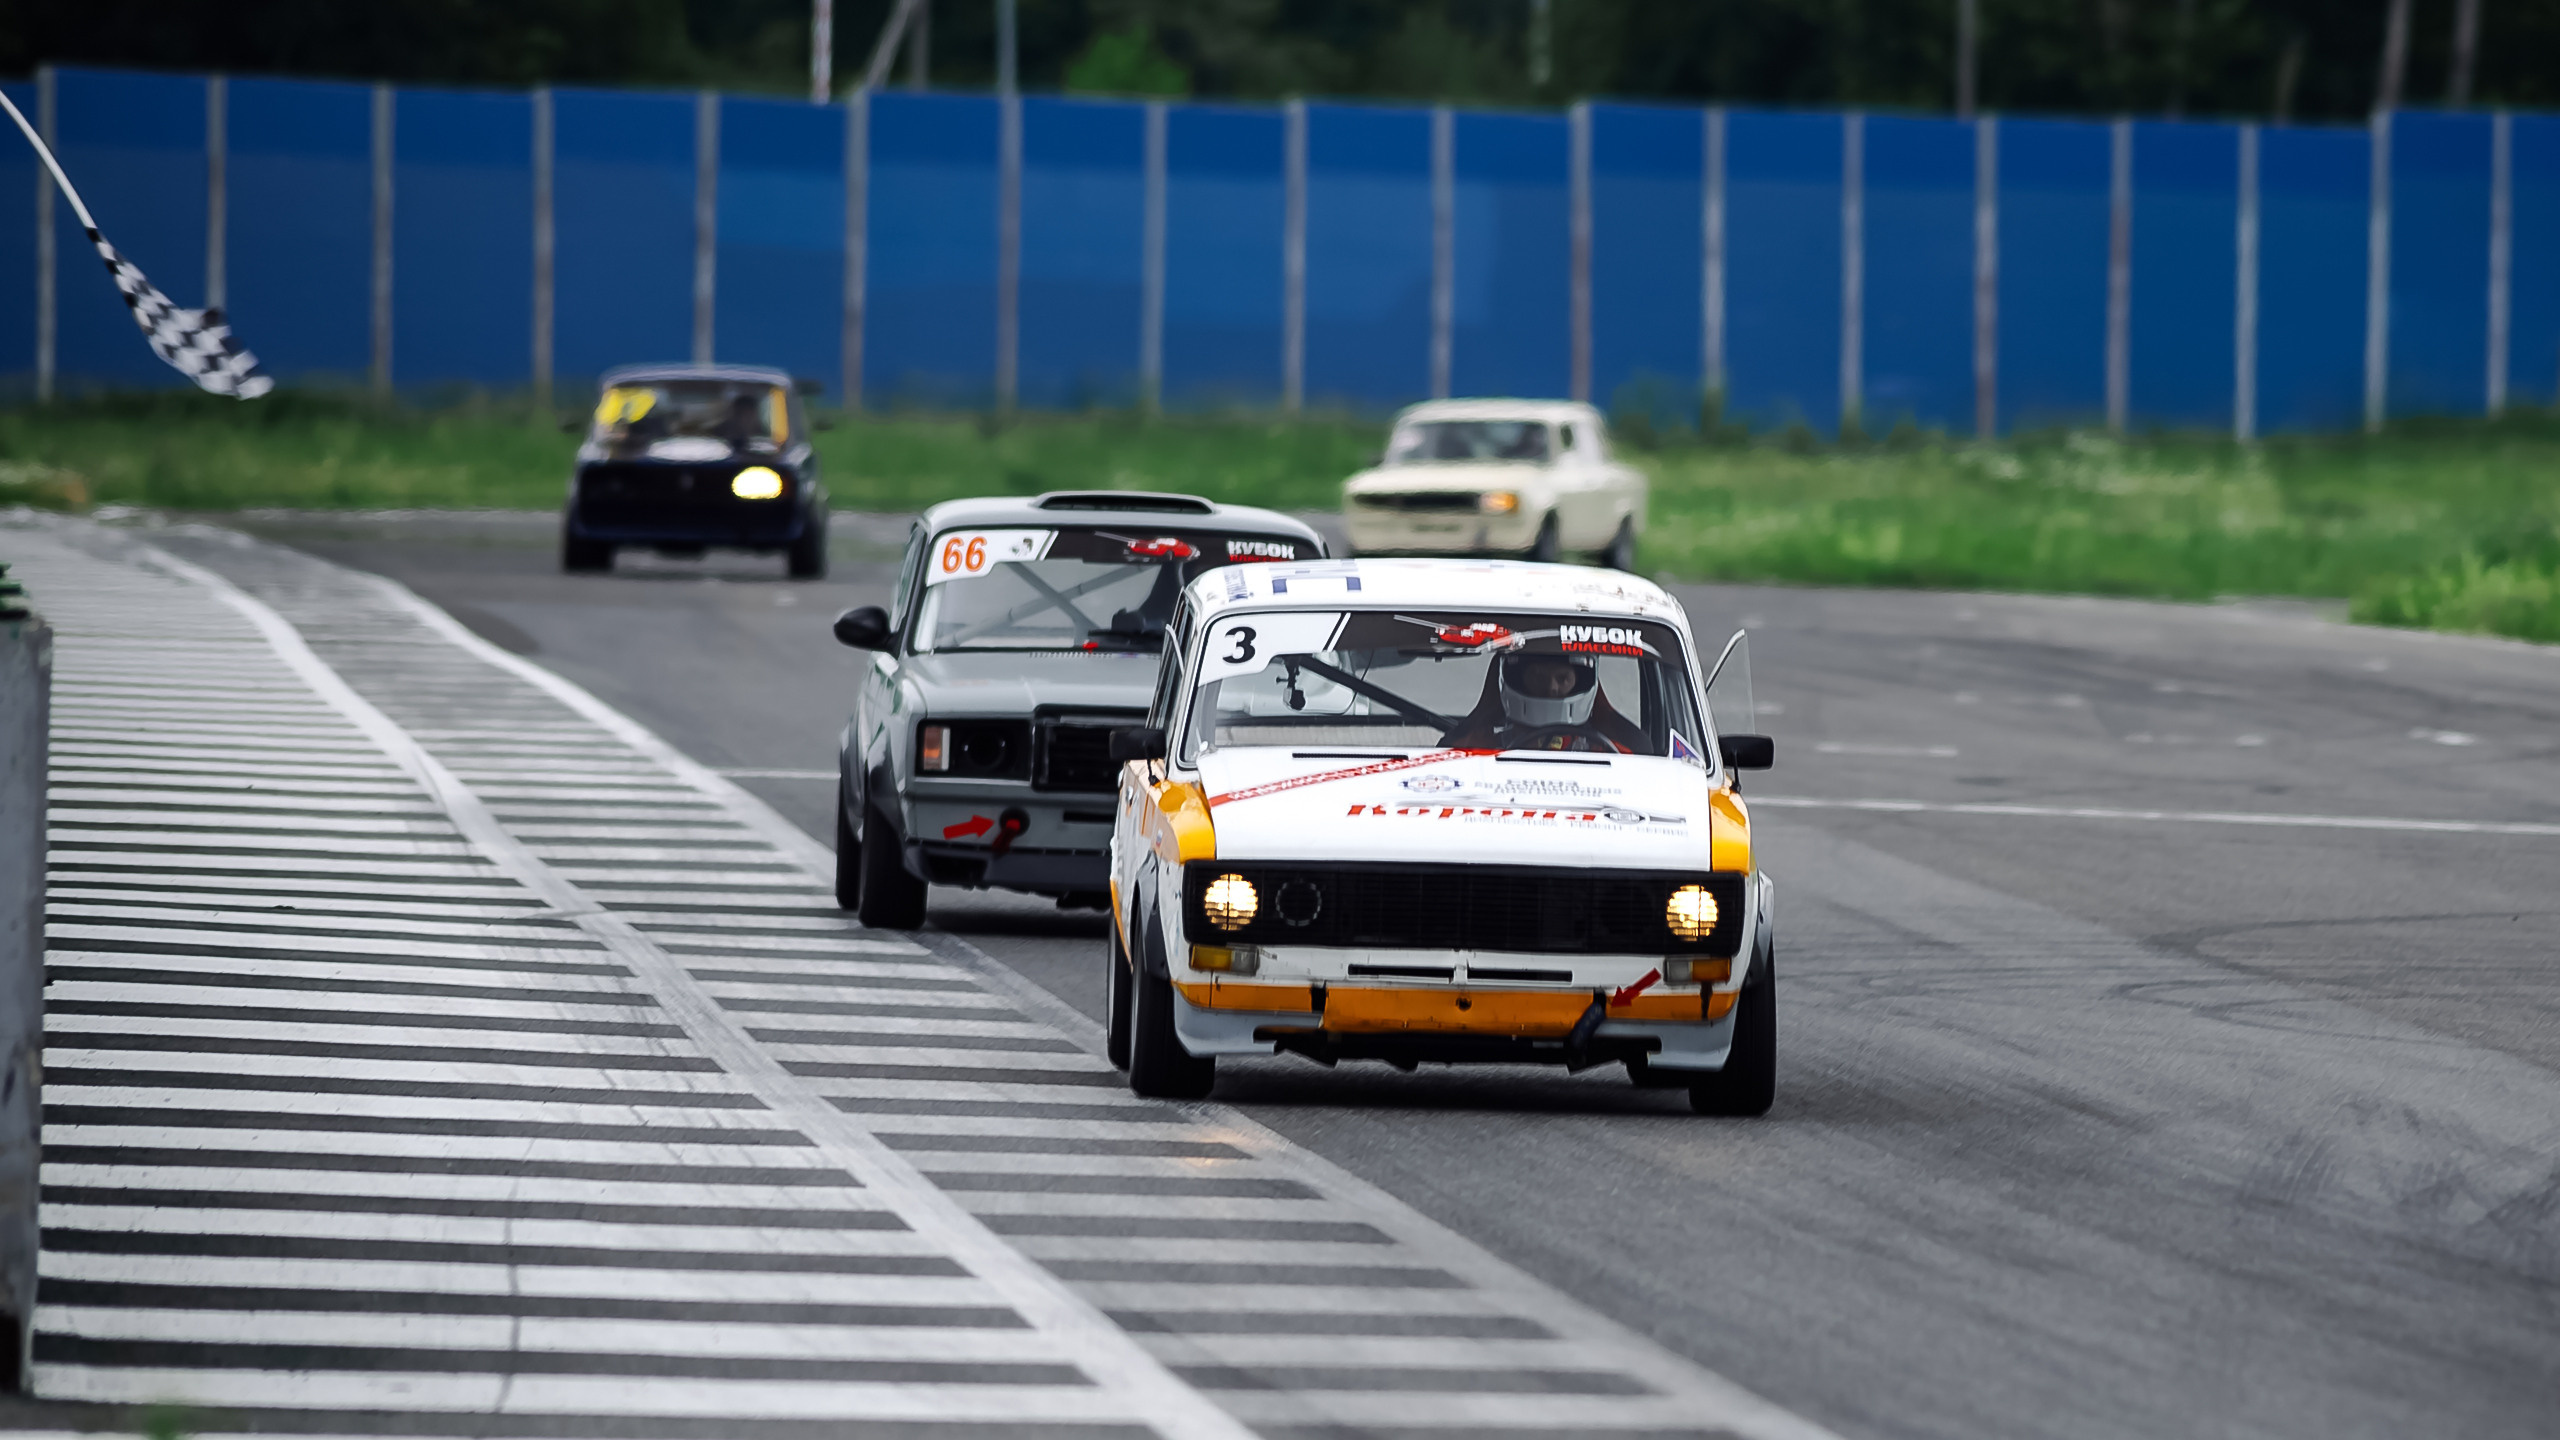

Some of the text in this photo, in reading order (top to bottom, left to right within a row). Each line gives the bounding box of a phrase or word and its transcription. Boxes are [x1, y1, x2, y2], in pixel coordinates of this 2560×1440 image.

[942, 536, 988, 574] 66
[1227, 541, 1295, 560] КУБОК
[1222, 626, 1257, 664] 3
[1560, 625, 1643, 647] КУБОК
